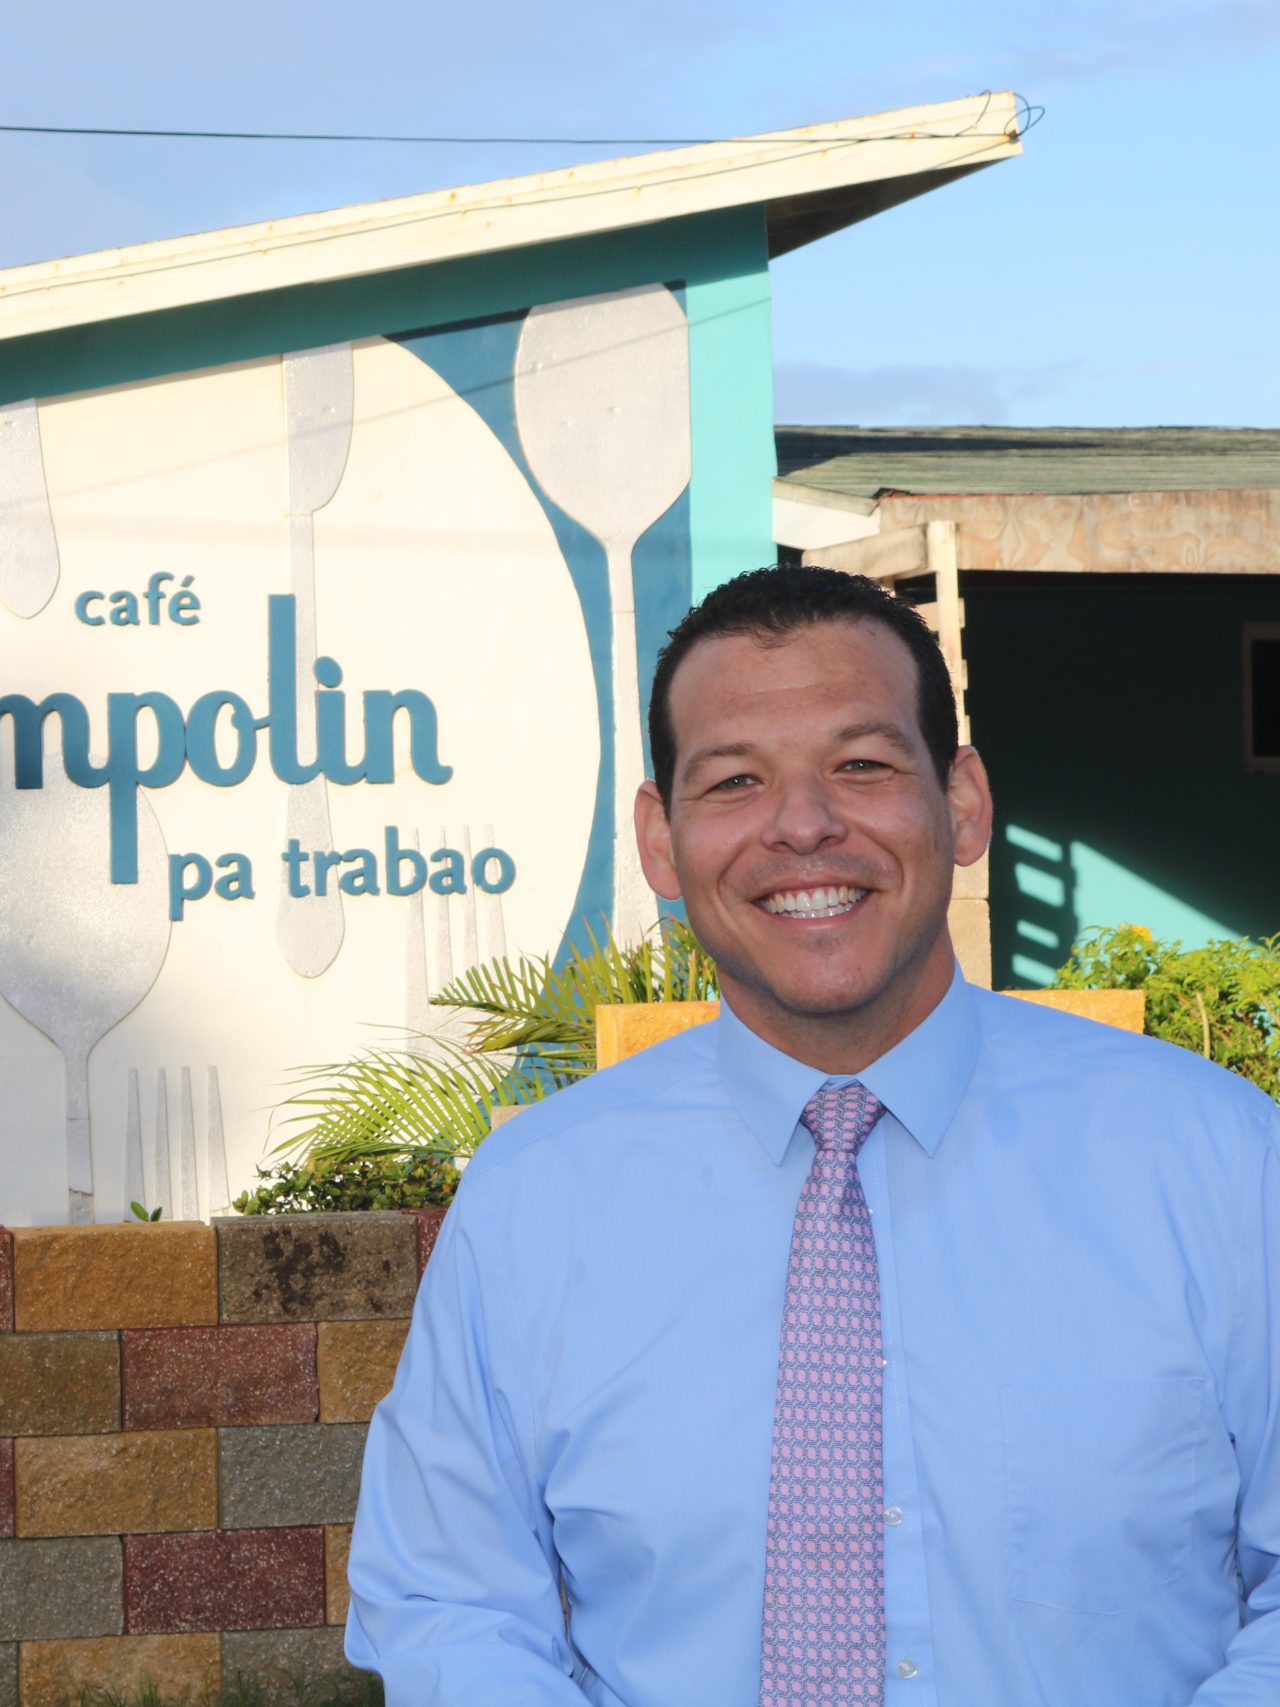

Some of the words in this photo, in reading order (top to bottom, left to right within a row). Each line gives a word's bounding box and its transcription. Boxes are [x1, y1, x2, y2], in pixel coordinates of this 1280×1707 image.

[74, 571, 201, 626] café
[169, 852, 255, 921] pa
[282, 826, 516, 897] trabao
